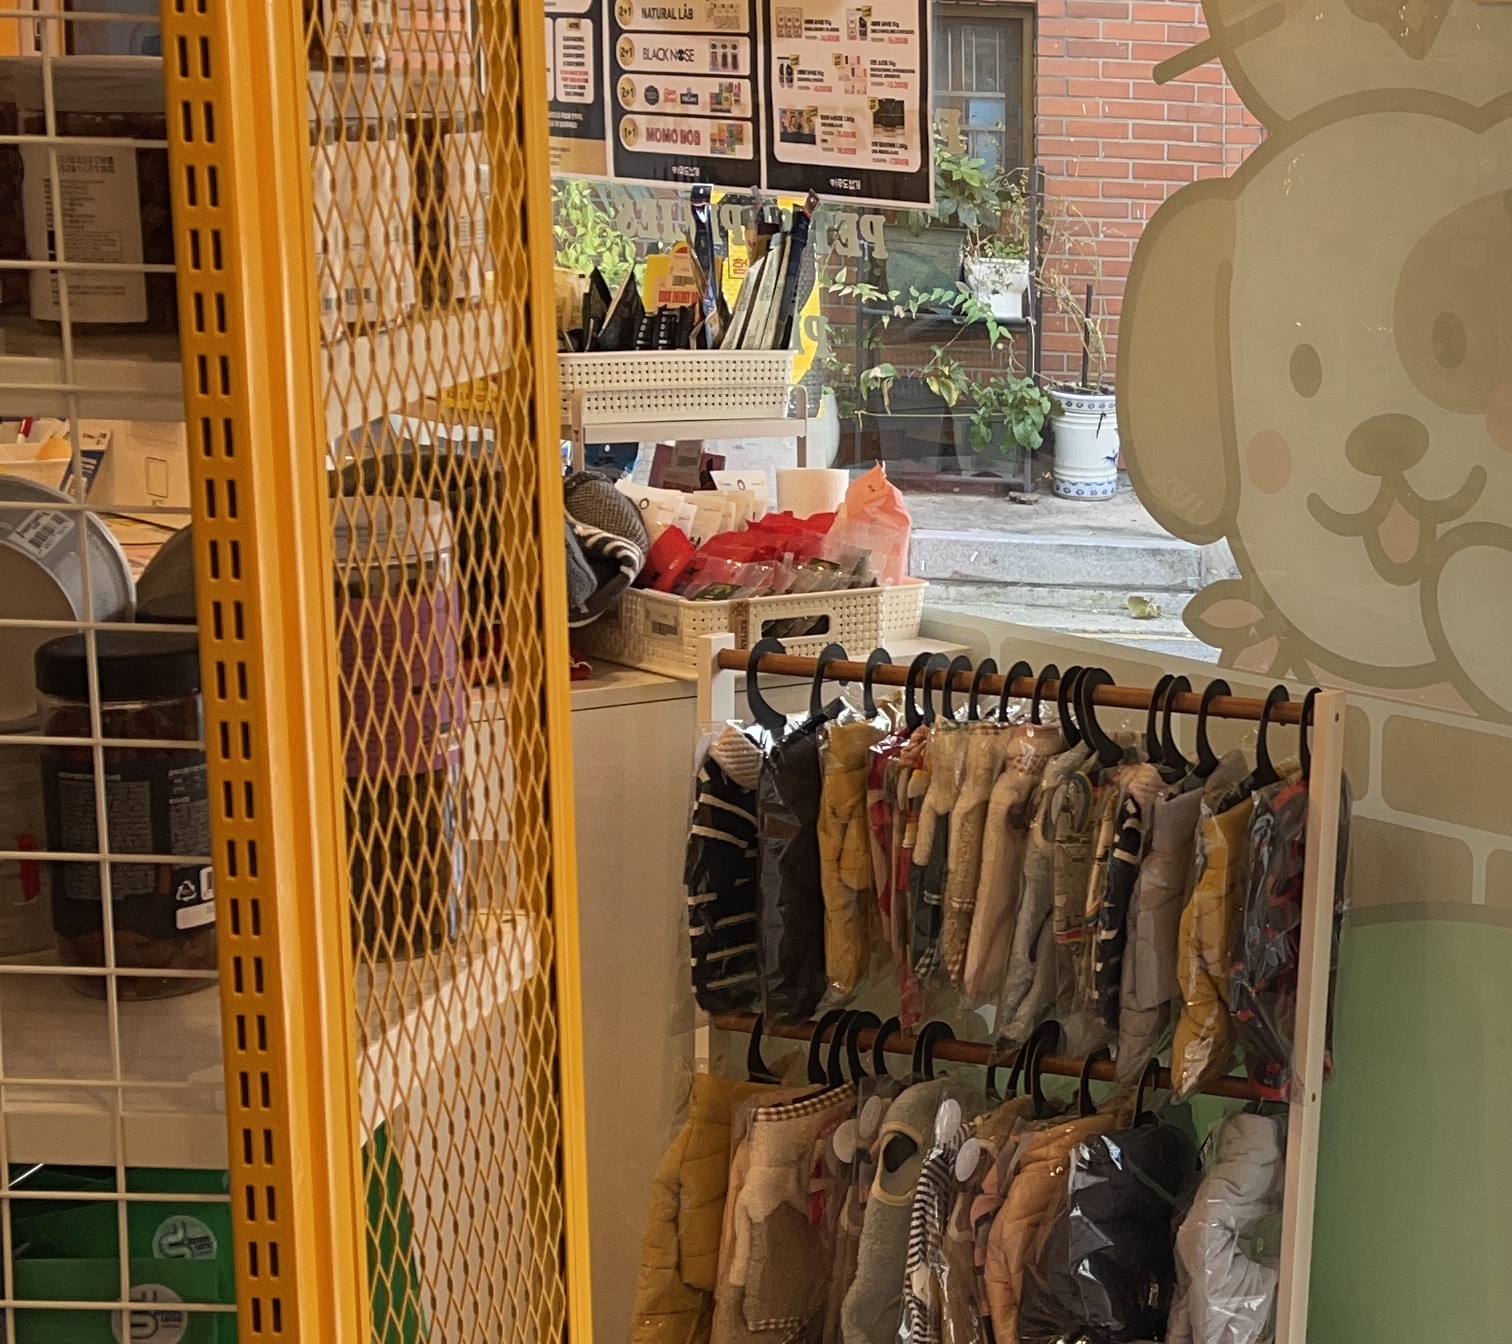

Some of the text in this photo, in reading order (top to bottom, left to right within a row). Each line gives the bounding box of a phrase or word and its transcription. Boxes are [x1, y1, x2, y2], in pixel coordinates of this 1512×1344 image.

[618, 5, 632, 17] 2+1
[641, 7, 677, 20] NATURAL
[620, 47, 633, 58] 2+1
[642, 47, 669, 62] BLACK
[621, 87, 635, 98] 2+1
[624, 127, 637, 138] 1+1
[645, 127, 678, 144] MOMO
